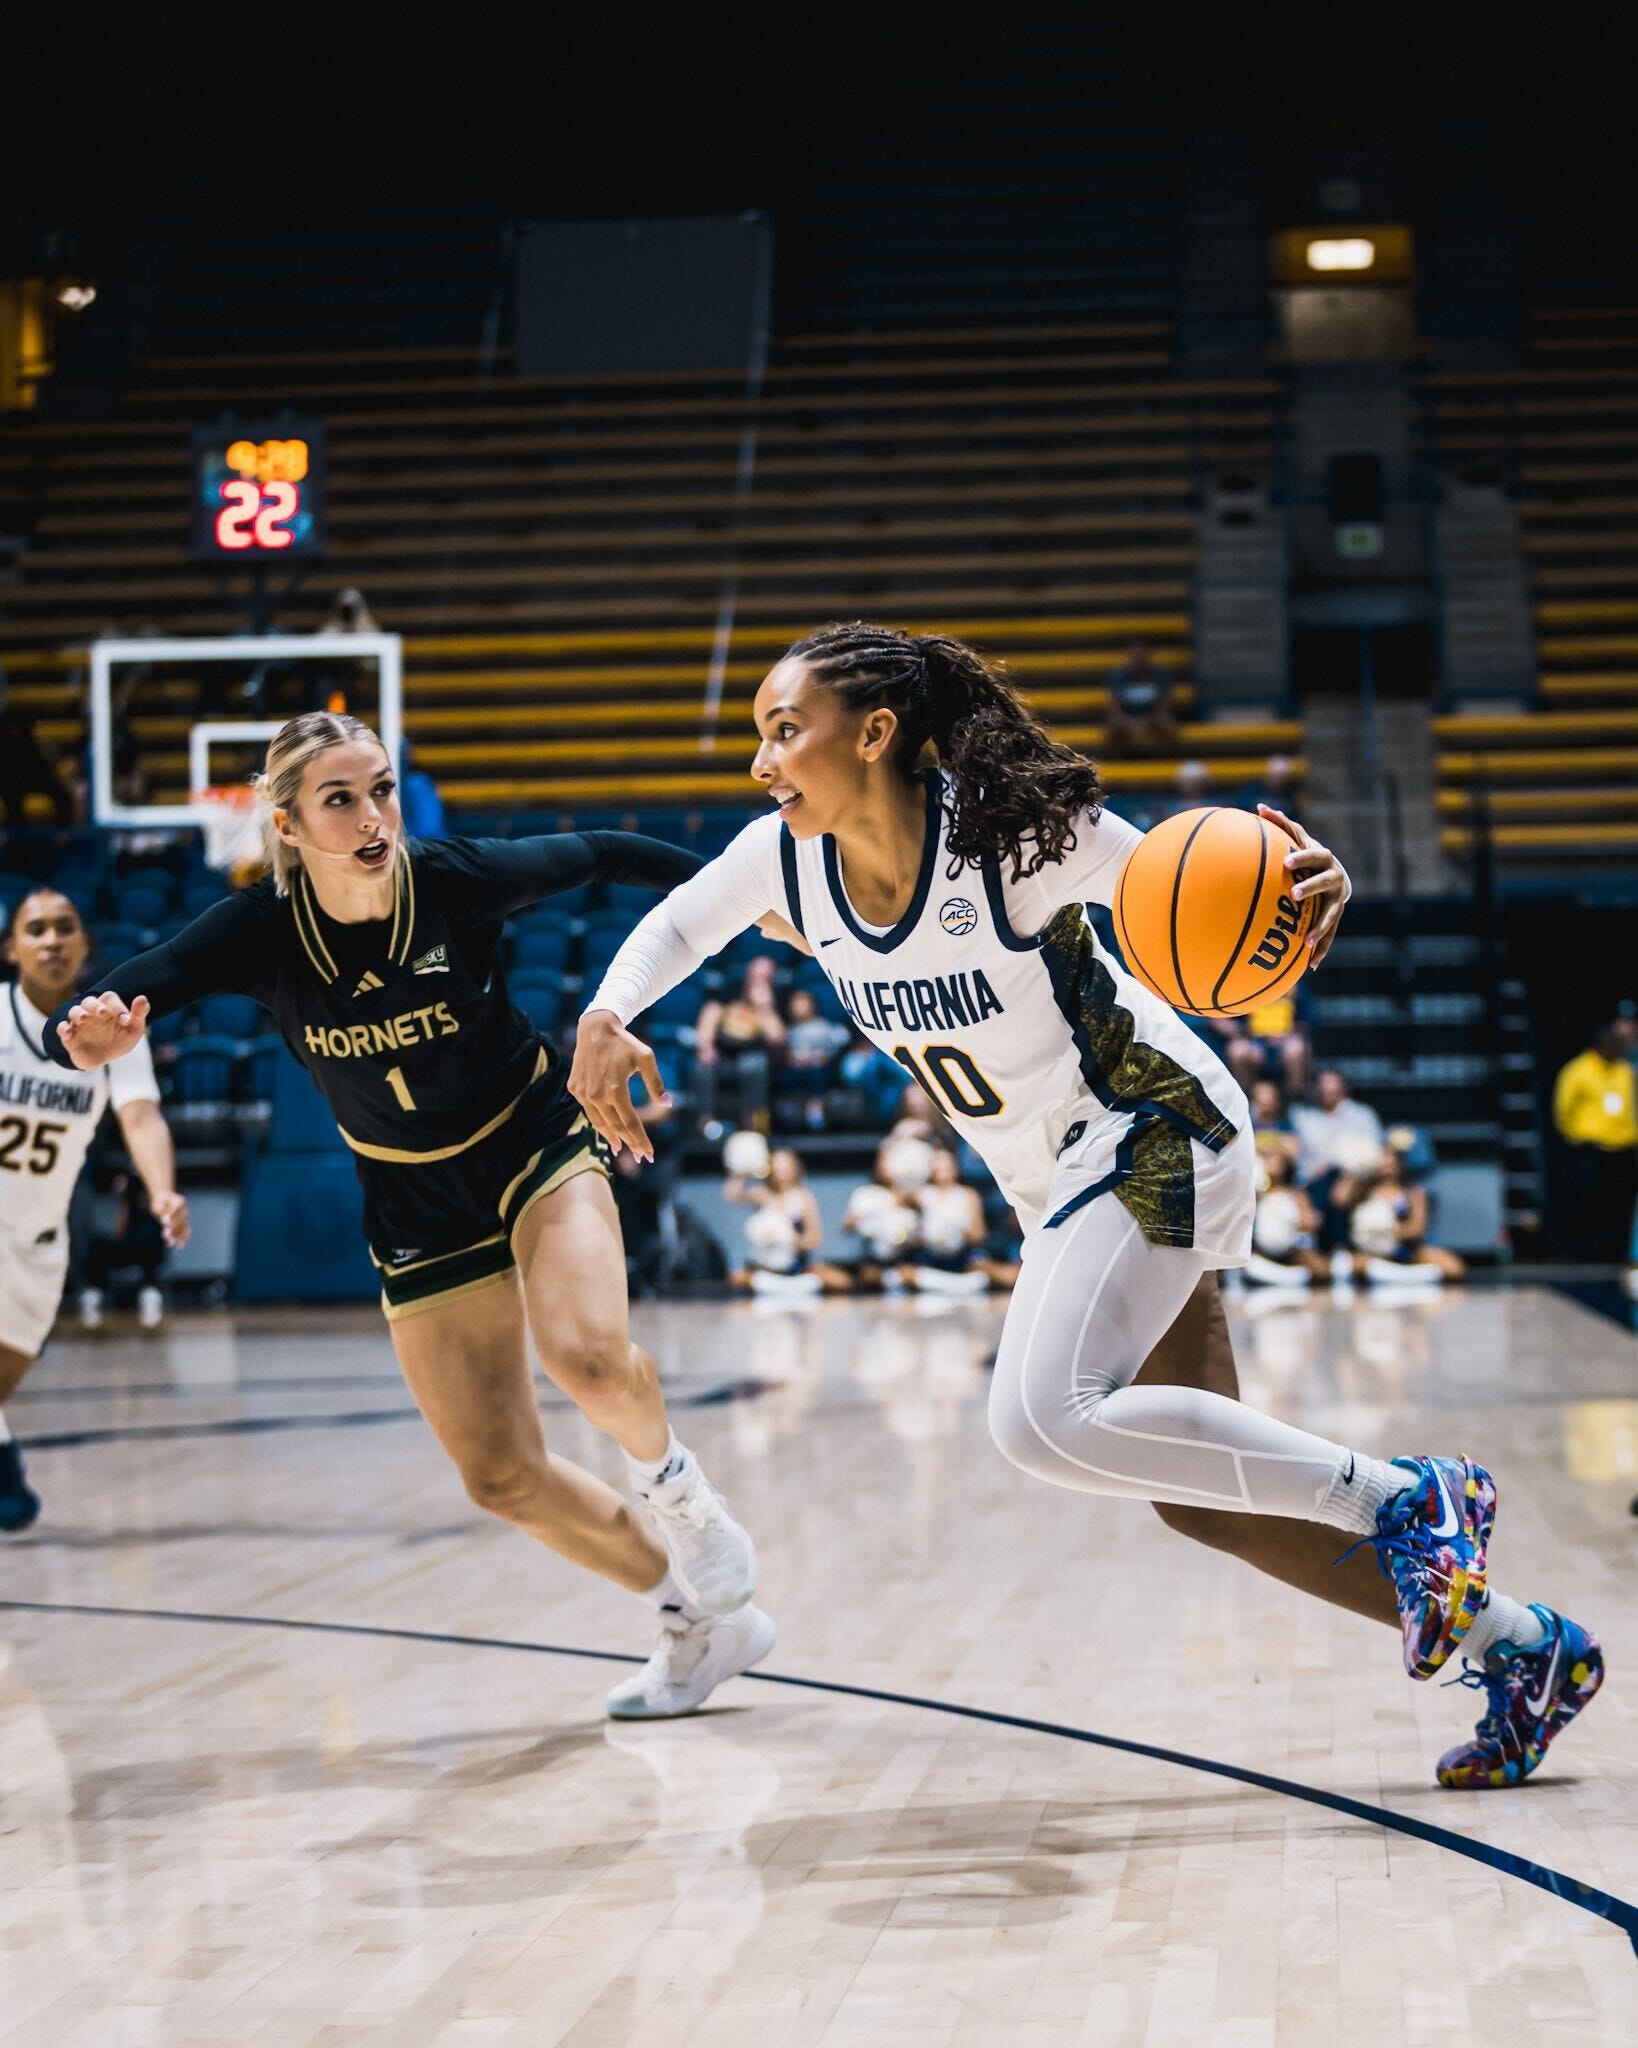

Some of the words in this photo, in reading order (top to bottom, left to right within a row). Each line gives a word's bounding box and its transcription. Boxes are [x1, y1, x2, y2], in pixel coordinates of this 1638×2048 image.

[215, 480, 298, 549] 22
[943, 908, 974, 921] ACC
[1248, 847, 1310, 970] Wil
[426, 947, 445, 964] SKY
[305, 1001, 459, 1058] HORNETS
[827, 968, 1004, 1031] ALIFORNIA
[385, 1066, 416, 1111] 1
[893, 1044, 1006, 1119] 10
[0, 1115, 68, 1175] 25
